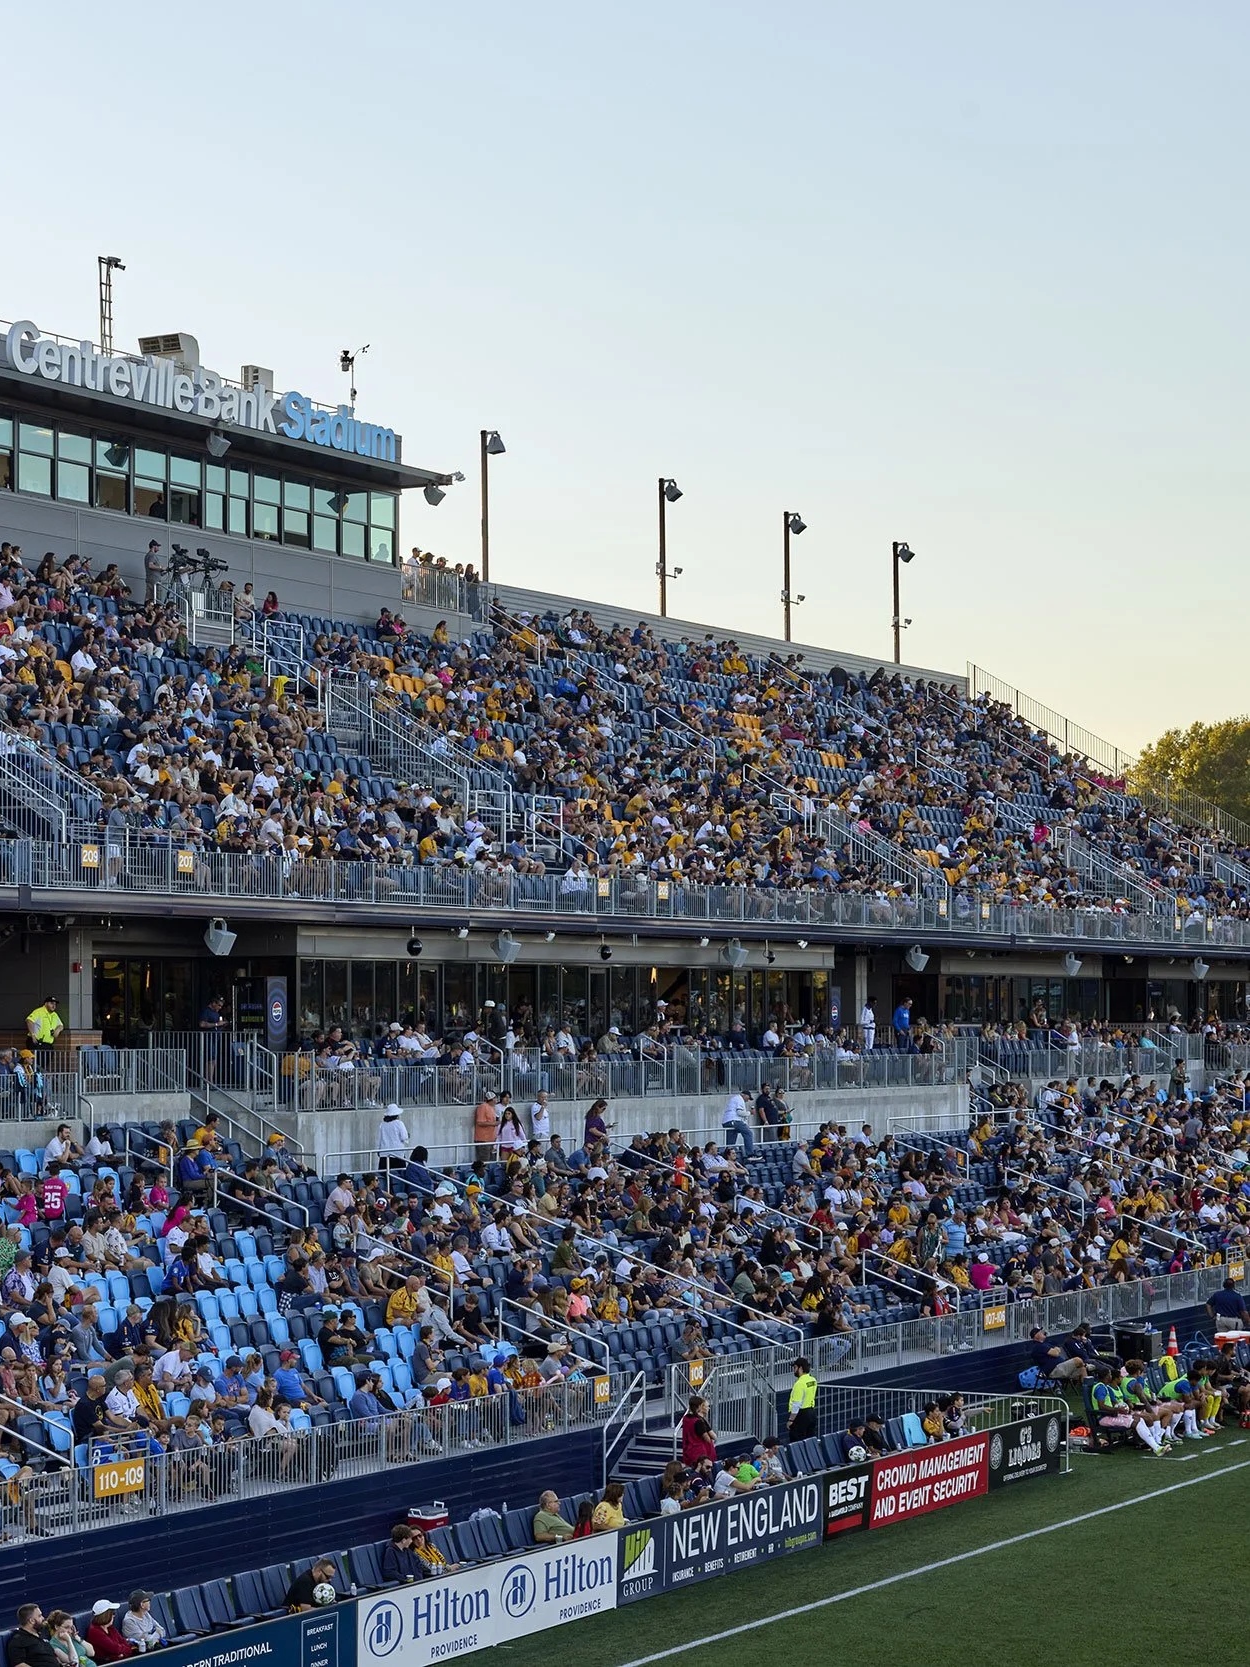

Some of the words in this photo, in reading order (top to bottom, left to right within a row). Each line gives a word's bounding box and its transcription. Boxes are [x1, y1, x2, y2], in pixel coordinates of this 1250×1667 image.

[196, 365, 278, 434] Bank
[279, 391, 397, 463] Stadium
[596, 1382, 609, 1398] 109
[877, 1462, 917, 1492] CROWD
[918, 1443, 985, 1481] MANAGEMENT
[1008, 1440, 1042, 1467] LIQUORS
[828, 1475, 869, 1507] BEST
[873, 1495, 896, 1521] AND
[898, 1484, 932, 1513] EVENT
[933, 1470, 980, 1503] SECURITY
[672, 1509, 722, 1563] NEW
[727, 1483, 819, 1546] ENGLAND
[543, 1553, 613, 1602] Hilton
[671, 1566, 695, 1583] INSURANCE
[704, 1558, 724, 1573] BENEFITS
[734, 1548, 757, 1564] RETIREMENT
[767, 1543, 775, 1554] HR
[622, 1577, 654, 1597] GROUP
[411, 1587, 491, 1640] Hilton
[559, 1598, 602, 1620] PROVIDENCE
[306, 1623, 334, 1637] BREAKFAST
[212, 1641, 273, 1667] TRADITIONAL
[310, 1641, 328, 1652] LUNCH
[430, 1633, 478, 1659] PROVIDENCE
